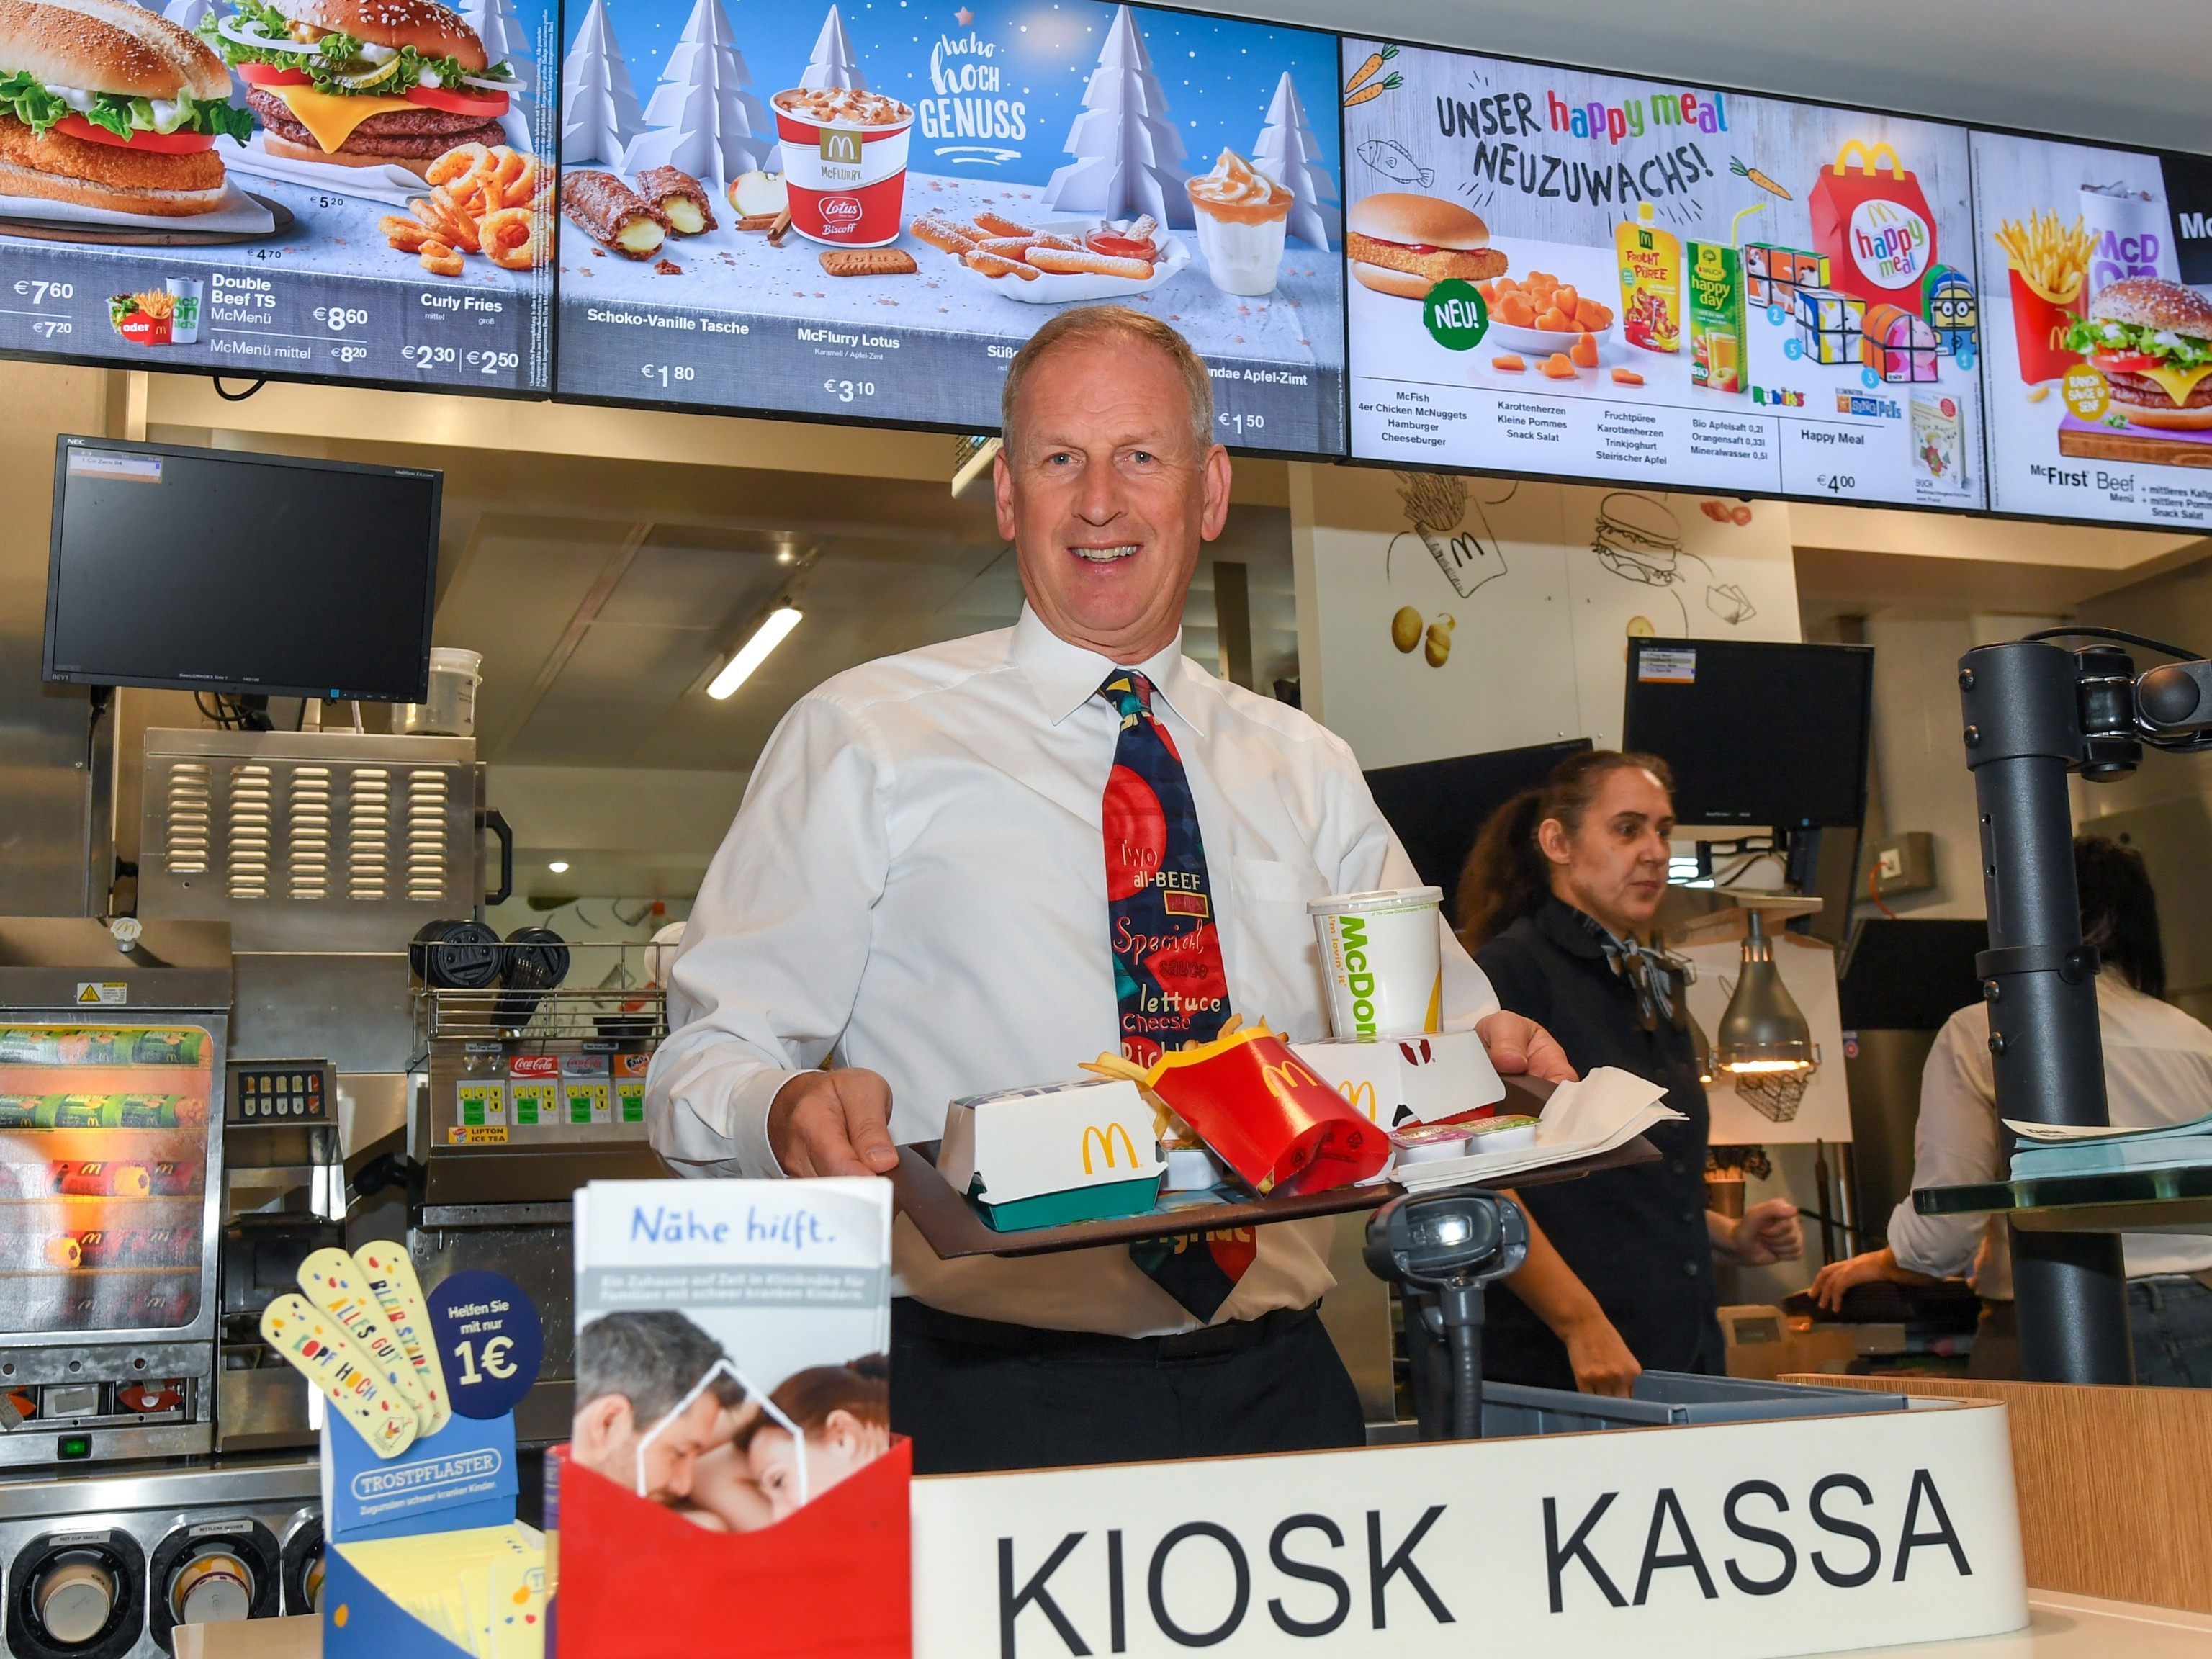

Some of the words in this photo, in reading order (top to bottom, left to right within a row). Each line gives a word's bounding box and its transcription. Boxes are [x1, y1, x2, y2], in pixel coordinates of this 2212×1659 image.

[941, 31, 996, 58] hoho
[919, 97, 1026, 140] GENUSS
[1437, 92, 1542, 139] UNSER
[1547, 89, 1645, 145] happy
[1651, 92, 1728, 134] meal
[1473, 140, 1714, 207] NEUZUWACHS!
[826, 199, 858, 215] Lotus
[822, 222, 858, 236] Biscoff
[1855, 217, 1925, 259] happy
[1634, 264, 1668, 281] PÜREE
[1879, 253, 1917, 278] meal
[212, 273, 271, 292] Double
[1692, 274, 1730, 298] happy
[212, 289, 251, 306] Beef
[254, 293, 276, 308] TS
[421, 292, 462, 311] Curly
[464, 296, 503, 313] Fries
[1699, 293, 1724, 310] day
[211, 307, 271, 325] McMenü
[424, 313, 446, 321] mittel
[587, 308, 696, 331] Schoko-Vanille
[700, 318, 750, 335] Tasche
[1434, 299, 1479, 329] NEU!
[122, 323, 150, 333] oder
[797, 328, 859, 347] McFlurry
[861, 334, 900, 349] Lotus
[210, 338, 271, 356] McMenü
[274, 346, 311, 360] mittel
[814, 348, 843, 357] Karamell
[1244, 369, 1308, 386] Apfel-Zimt
[1396, 391, 1430, 403] McFish
[1358, 402, 1374, 412] 4er
[1375, 403, 1413, 415] Chicken
[1415, 406, 1467, 421] McNuggets
[1498, 400, 1567, 415] Karottenherzen
[1388, 418, 1439, 432] Hamburger
[1498, 415, 1527, 426] Kleine
[1528, 417, 1568, 429] Pommes
[1604, 410, 1656, 423] Fruchtpüree
[1596, 423, 1664, 438] Karottenherzen
[1692, 419, 1707, 428] Bio
[1709, 420, 1747, 433] Apfelsaft
[1381, 432, 1447, 446] Cheeseburger
[1507, 429, 1535, 440] Snack
[1537, 431, 1560, 442] Salat
[1605, 437, 1657, 451] Trinkjoghurt
[1691, 432, 1744, 446] Orangensaft
[1800, 429, 1835, 445] Happy
[1838, 433, 1865, 445] Meal
[1596, 450, 1642, 463] Steirischer
[1644, 453, 1667, 465] Apfel
[1691, 446, 1751, 459] Mineralwasser
[2096, 471, 2135, 492] Beef
[2109, 492, 2135, 503] Menü
[2149, 486, 2188, 498] mittleres
[2149, 497, 2183, 508] mittlere
[2152, 507, 2179, 518] Snack
[2181, 510, 2204, 521] Salat
[1133, 870, 1200, 891] all-BEEF
[1332, 938, 1344, 971] lovin'
[1338, 974, 1345, 984] it
[1159, 960, 1208, 980] sauce
[1139, 983, 1221, 1012] lettuce
[631, 1205, 730, 1244] Nähe
[747, 1205, 836, 1251] hilft.
[447, 1302, 487, 1320] Helfen
[490, 1300, 510, 1315] Sie
[327, 1297, 377, 1339] ALLES
[371, 1337, 403, 1366] GUT
[459, 1321, 480, 1335] mit
[482, 1319, 503, 1331] nur
[292, 1334, 338, 1367] KOPF
[334, 1361, 378, 1402] HOCH
[453, 1335, 518, 1386] 1€
[361, 1453, 495, 1494] TROSTPFLASTER
[360, 1499, 405, 1516] Zugunsten
[997, 1503, 1457, 1659] KIOSK
[1542, 1467, 1974, 1616] KASSA
